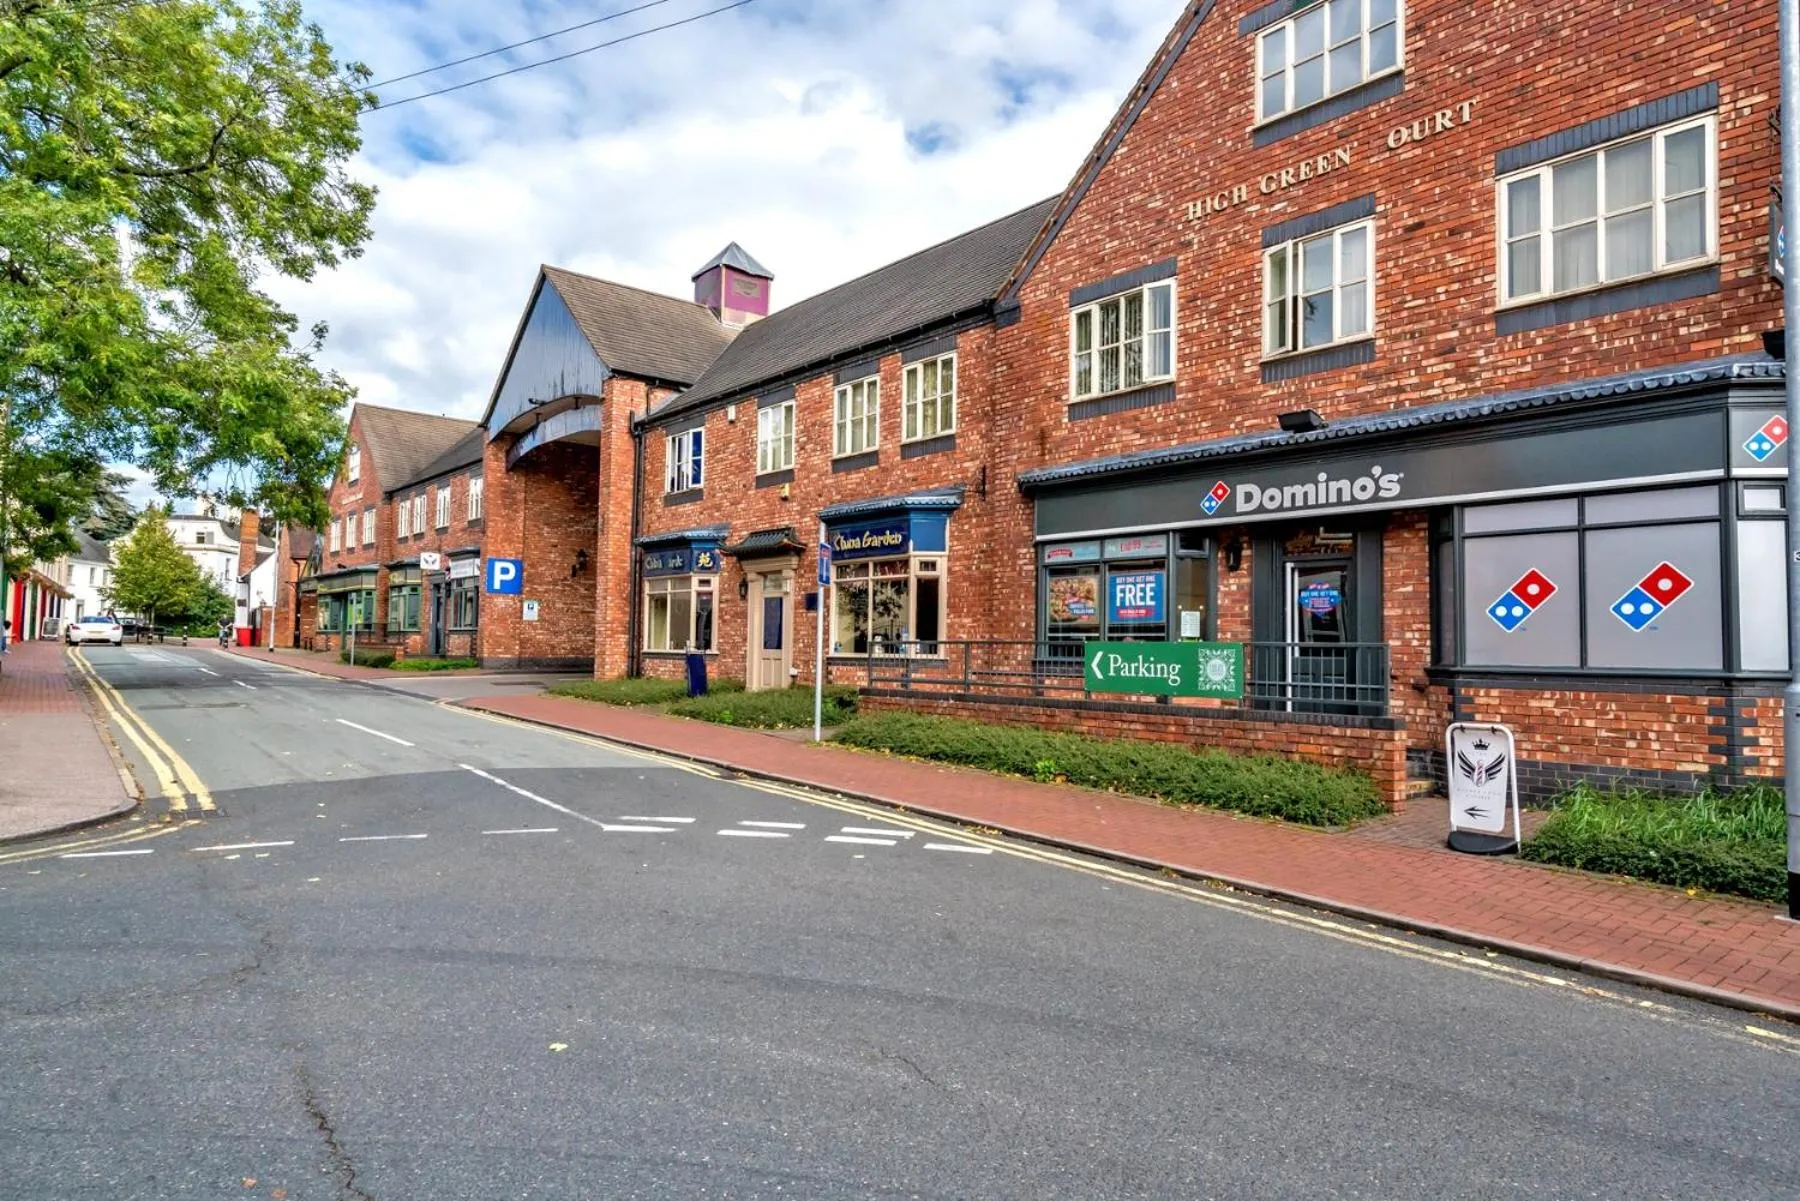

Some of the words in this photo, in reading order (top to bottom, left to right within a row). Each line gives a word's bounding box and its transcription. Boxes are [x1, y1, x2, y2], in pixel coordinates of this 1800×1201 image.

[1186, 182, 1249, 222] HIGH
[1258, 146, 1353, 195] GREEN
[1386, 98, 1477, 150] OURT
[1235, 464, 1402, 514] Domino's
[493, 561, 516, 590] P
[1116, 583, 1156, 607] FREE
[1106, 653, 1182, 686] Parking
